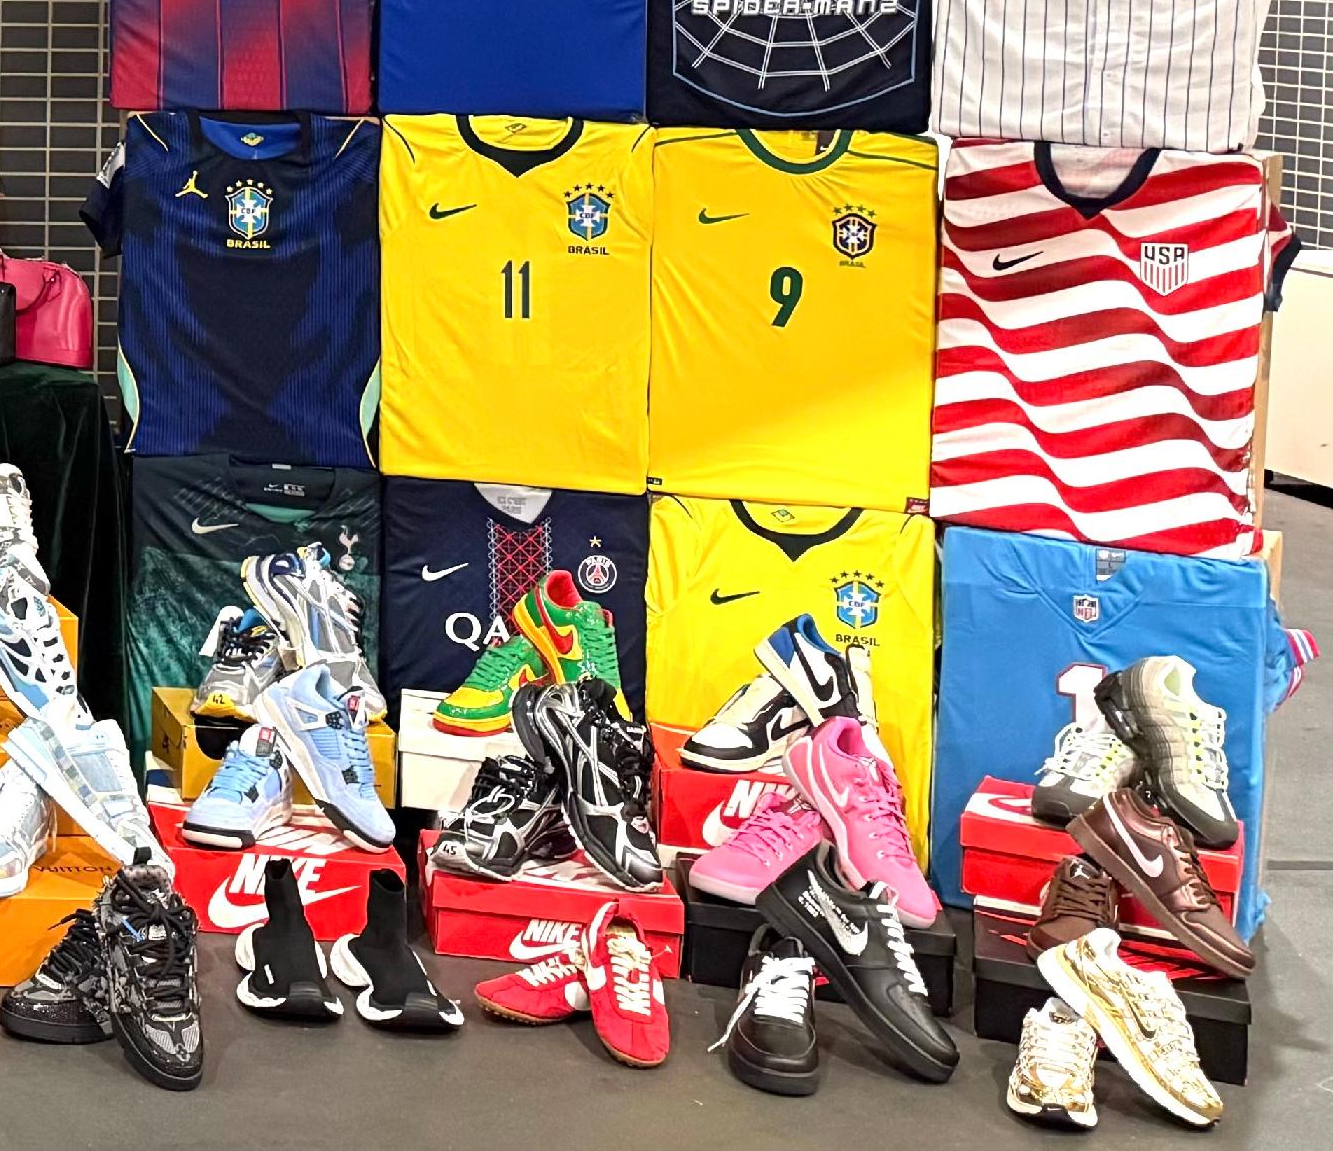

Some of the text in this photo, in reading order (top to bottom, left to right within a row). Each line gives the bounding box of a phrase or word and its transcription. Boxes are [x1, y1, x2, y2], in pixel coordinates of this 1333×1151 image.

[226, 238, 271, 250] BRASIL
[568, 245, 610, 256] BRASIL
[1144, 244, 1185, 265] USA
[501, 260, 531, 320] 11
[769, 266, 804, 328] 9
[835, 633, 881, 647] BRASIL
[443, 844, 457, 856] 45
[525, 920, 583, 944] NIKE
